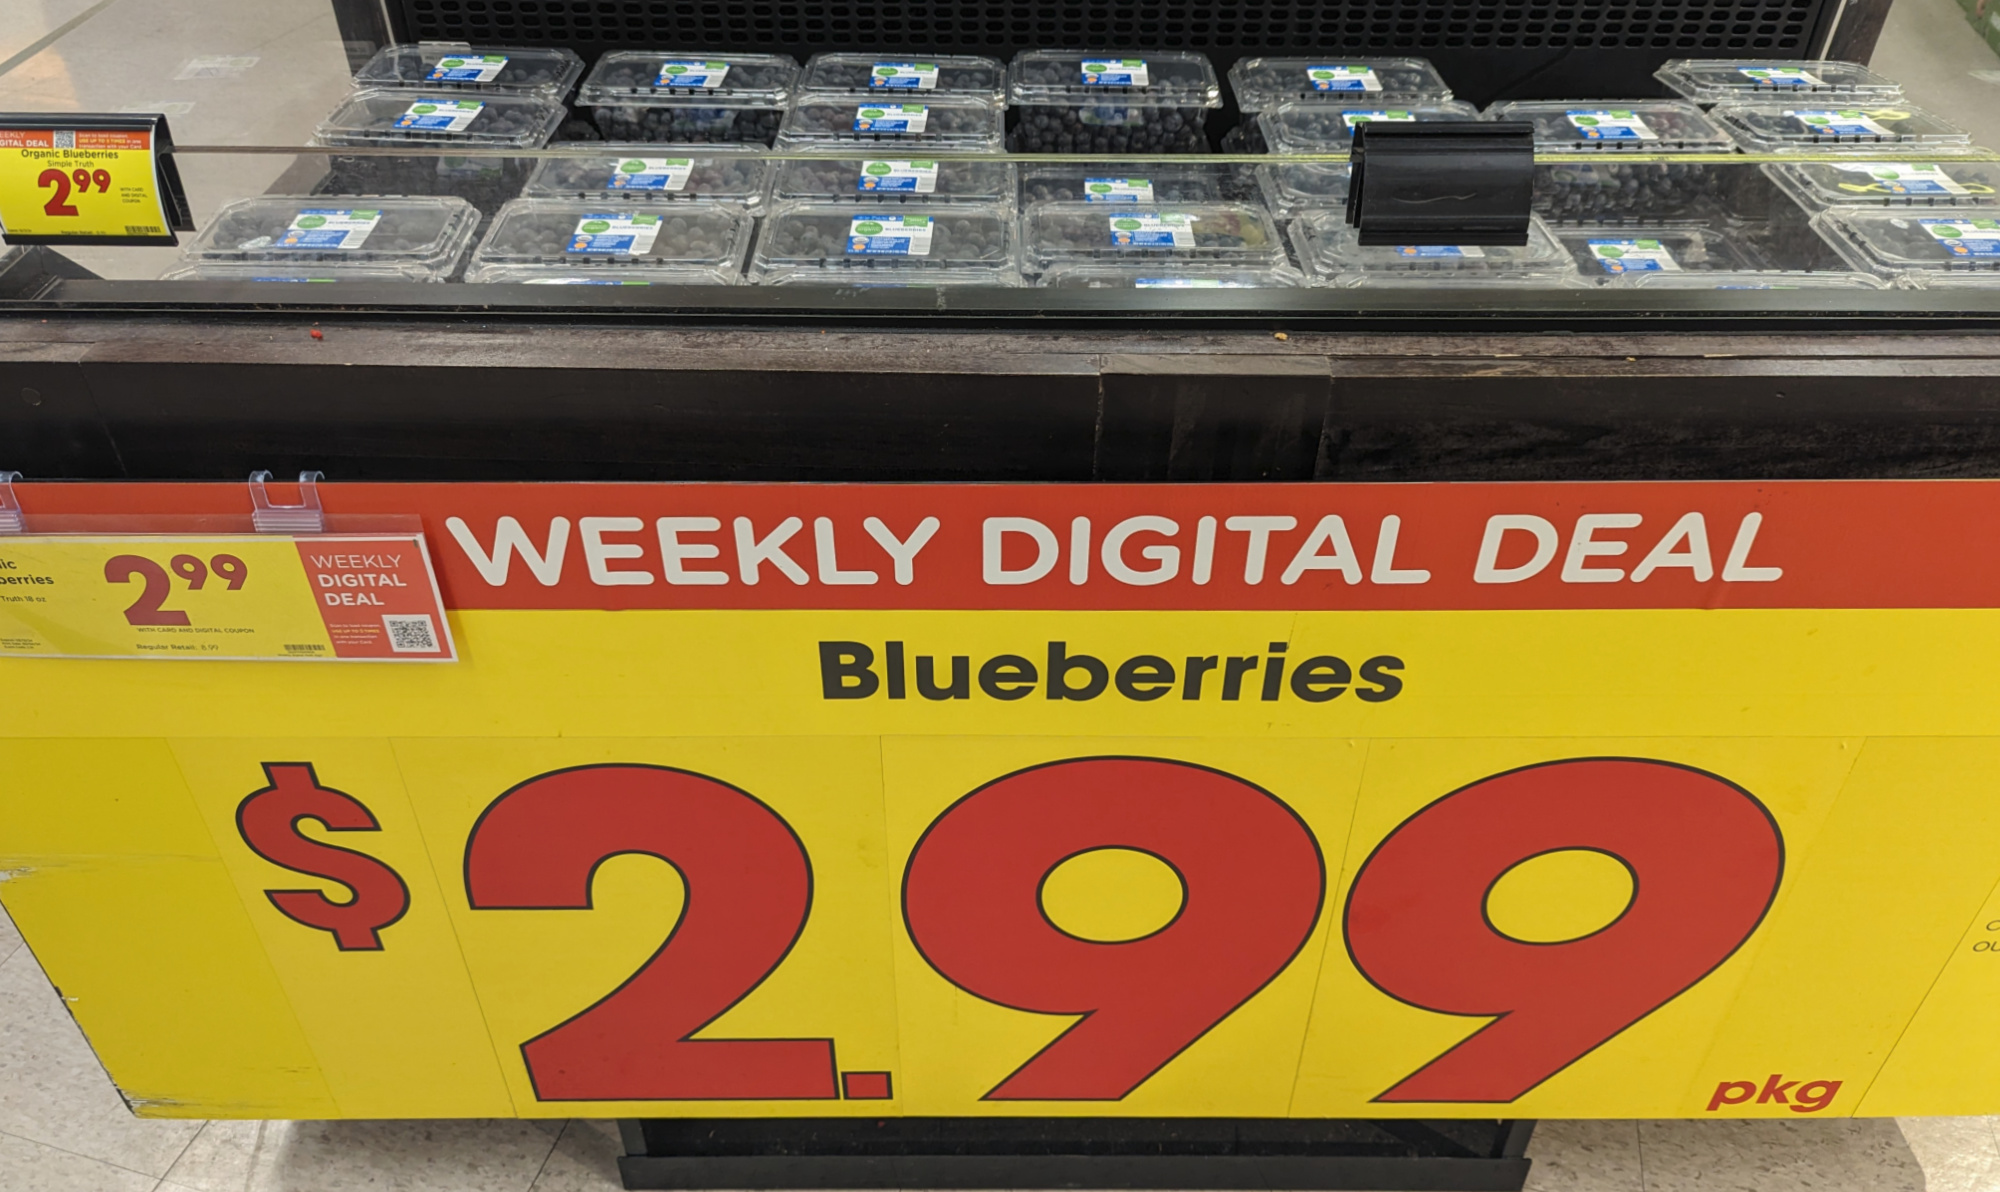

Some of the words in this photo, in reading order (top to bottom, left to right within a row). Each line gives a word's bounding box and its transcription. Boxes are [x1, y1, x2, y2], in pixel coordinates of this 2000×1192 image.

[26, 139, 49, 148] DEAL
[21, 149, 60, 159] Organic
[63, 150, 119, 159] Blueberries
[47, 160, 72, 168] Simple
[75, 160, 94, 168] Truth
[445, 515, 940, 587] WEEKLY
[982, 514, 1431, 586] DIGITAL
[1473, 512, 1782, 583] DEAL
[310, 554, 401, 568] WEEKLY
[317, 573, 407, 587] DIGITAL
[324, 592, 385, 606] DEAL
[136, 643, 168, 651] Regular
[818, 640, 1405, 703] Blueberries
[1705, 1074, 1843, 1112] pkg
